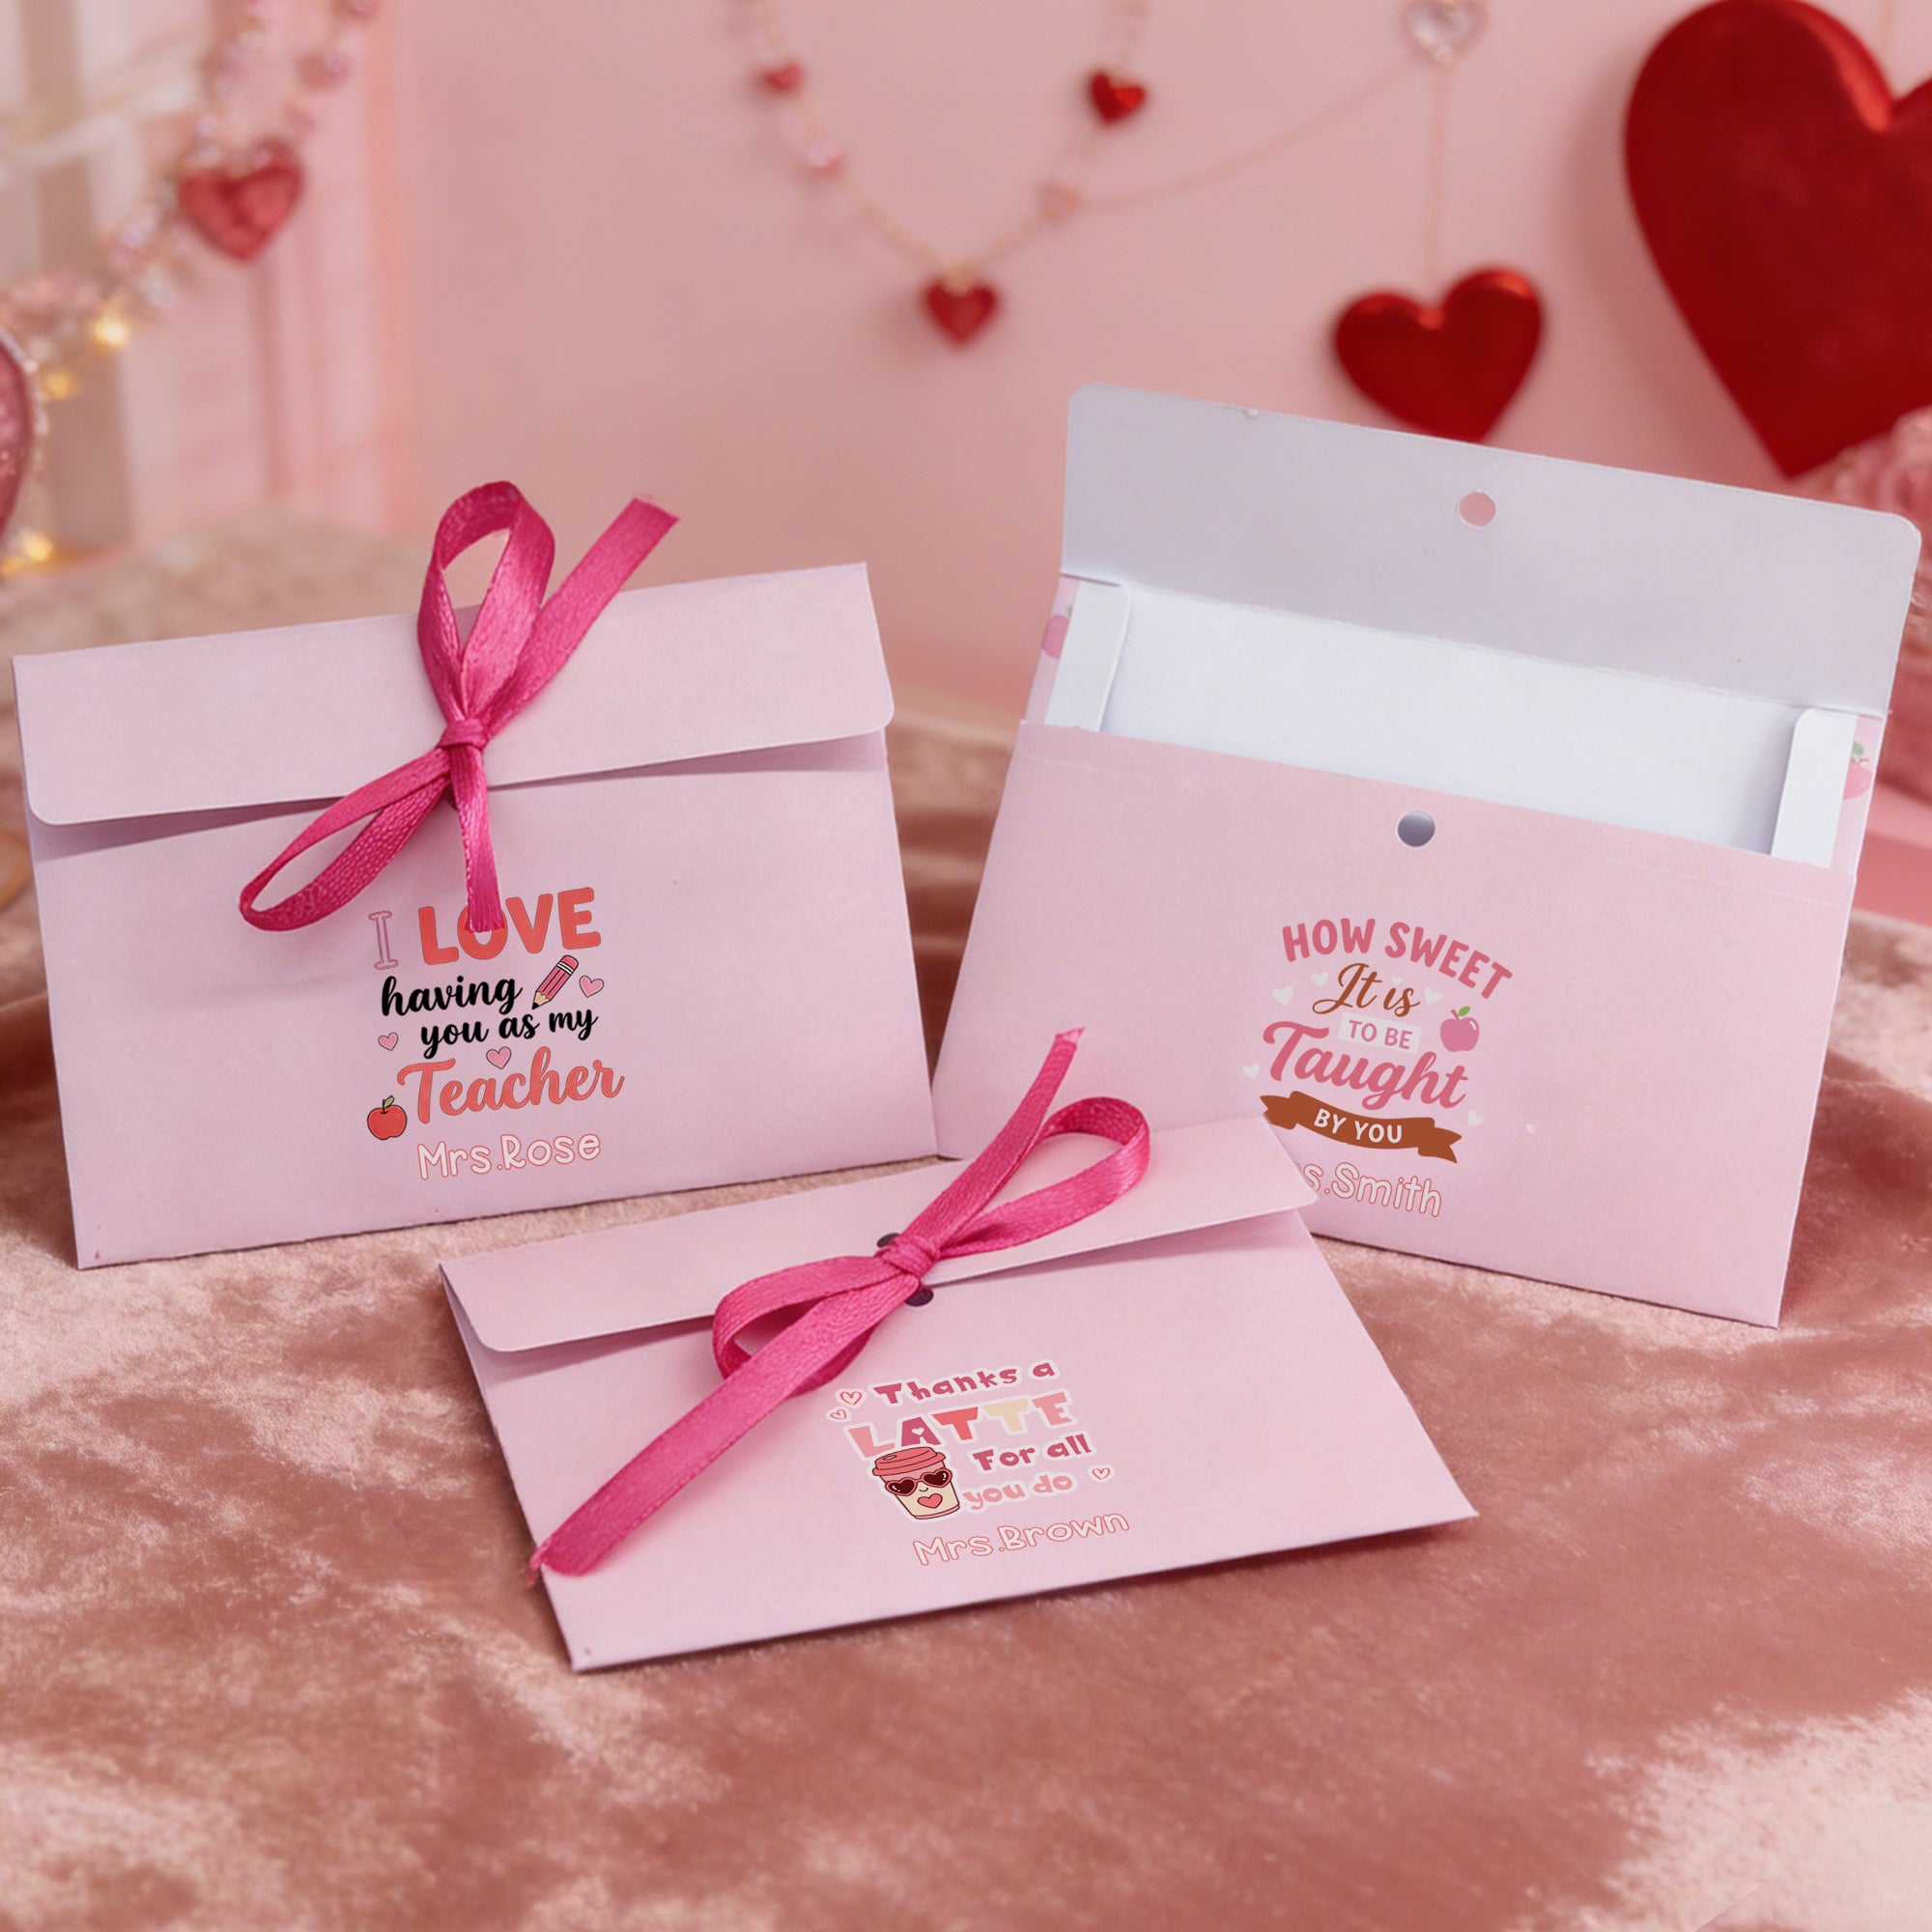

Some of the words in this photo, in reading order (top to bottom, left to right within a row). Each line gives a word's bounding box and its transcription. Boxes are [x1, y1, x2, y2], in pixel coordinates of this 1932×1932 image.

[368, 910, 400, 970] I
[417, 887, 602, 965] LOVE
[1282, 918, 1376, 962] HOW
[1384, 922, 1514, 1000] SWEET
[382, 975, 524, 1016] having
[1312, 962, 1382, 1014] It
[1383, 987, 1421, 1017] is
[420, 1021, 489, 1059] you
[498, 1013, 540, 1039] as
[549, 1009, 599, 1040] my
[1349, 1020, 1378, 1042] TO
[1384, 1027, 1413, 1050] BE
[397, 1046, 625, 1124] Teacher
[1263, 1021, 1468, 1110] Taught
[1314, 1108, 1348, 1134] BY
[1354, 1121, 1402, 1144] YOU
[417, 1133, 601, 1180] Mrs.Rose
[1294, 1161, 1442, 1218] s.Smith
[873, 1367, 1017, 1405] Thanks
[1032, 1362, 1055, 1378] a
[847, 1391, 1073, 1458] LATTE
[973, 1446, 1036, 1471] For
[1046, 1434, 1092, 1457] all
[962, 1482, 1025, 1510] you
[1033, 1474, 1073, 1493] do
[913, 1513, 1129, 1566] Mrs.Brown
